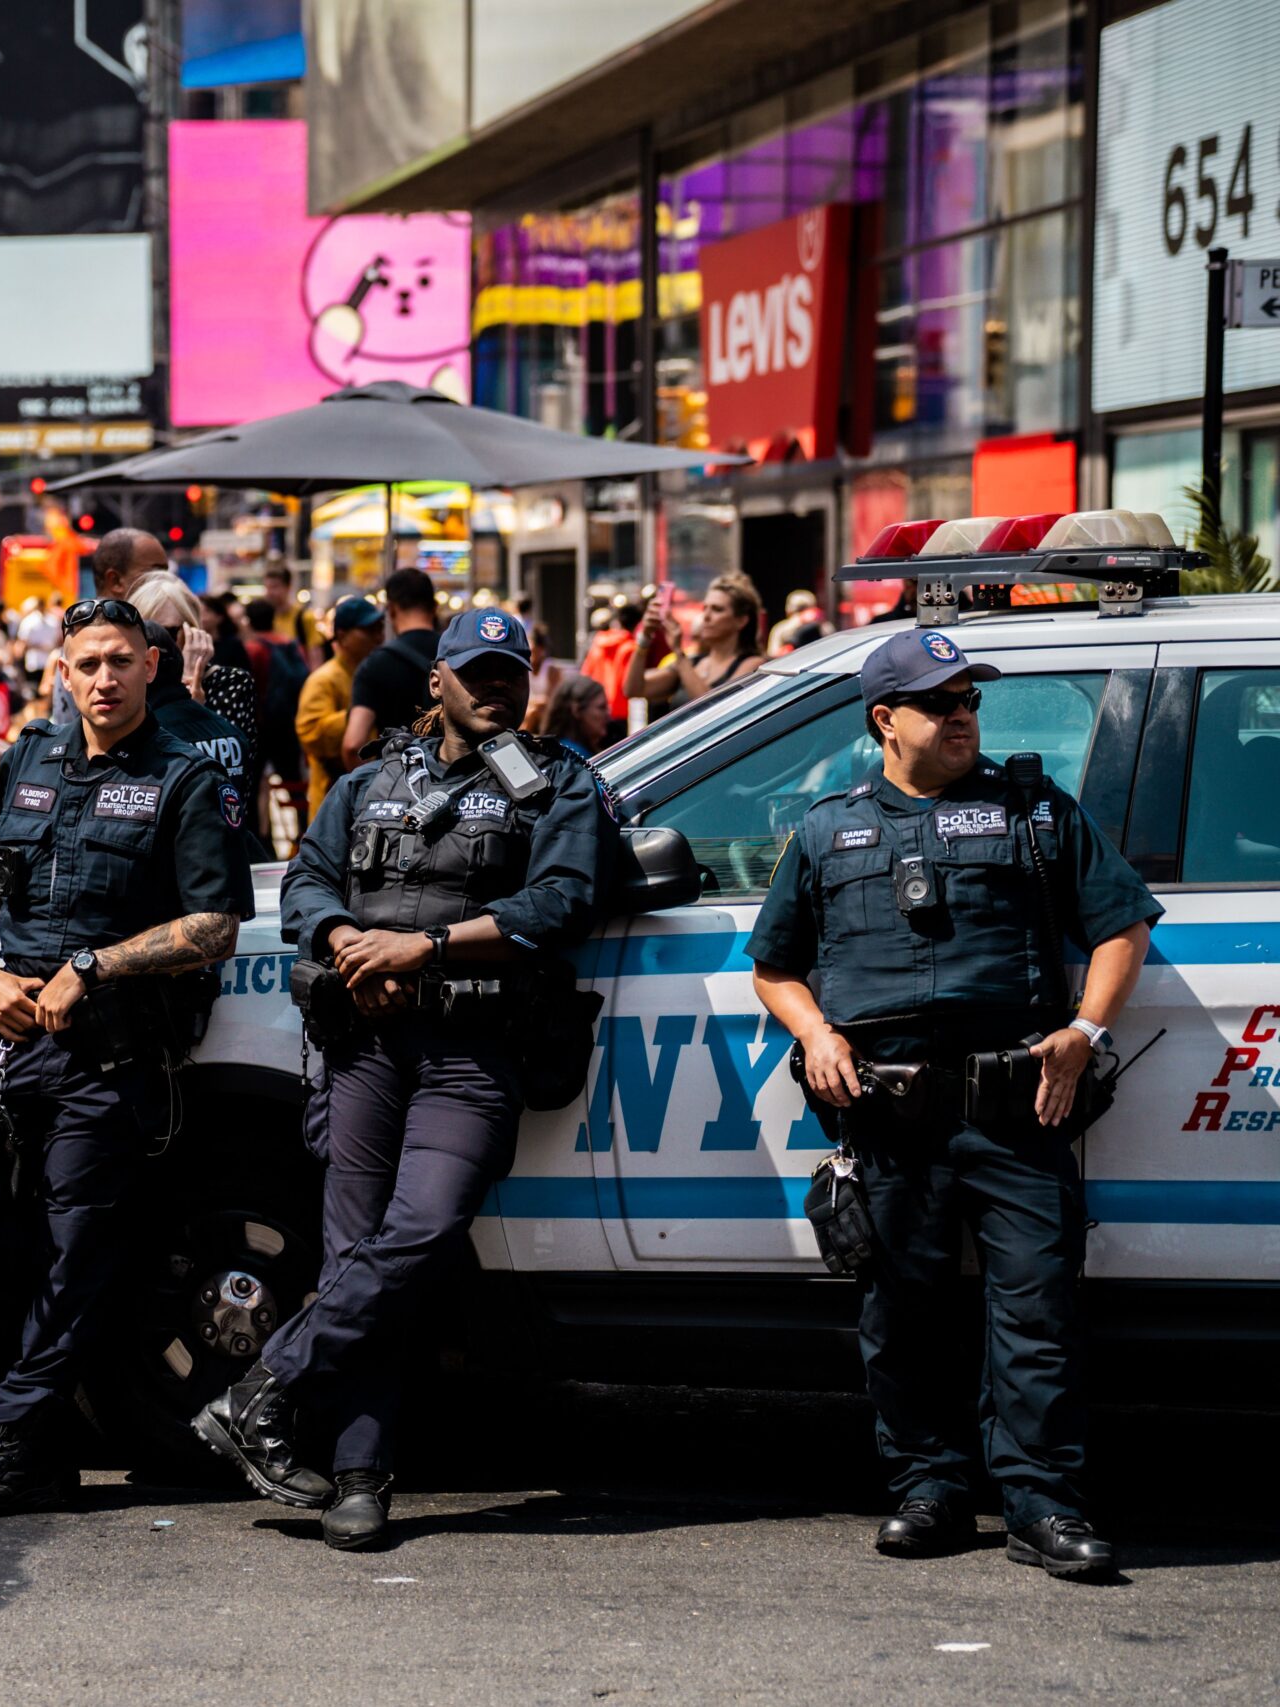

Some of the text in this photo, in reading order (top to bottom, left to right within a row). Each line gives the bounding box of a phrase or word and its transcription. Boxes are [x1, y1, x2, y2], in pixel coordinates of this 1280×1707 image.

[1163, 121, 1254, 255] 654
[19, 788, 49, 799] ALBERGO
[100, 789, 156, 805] POLICE
[113, 808, 136, 816] GROUP
[458, 797, 507, 812] OLICE
[937, 811, 1002, 828] POLICE
[842, 829, 873, 839] CARPIO
